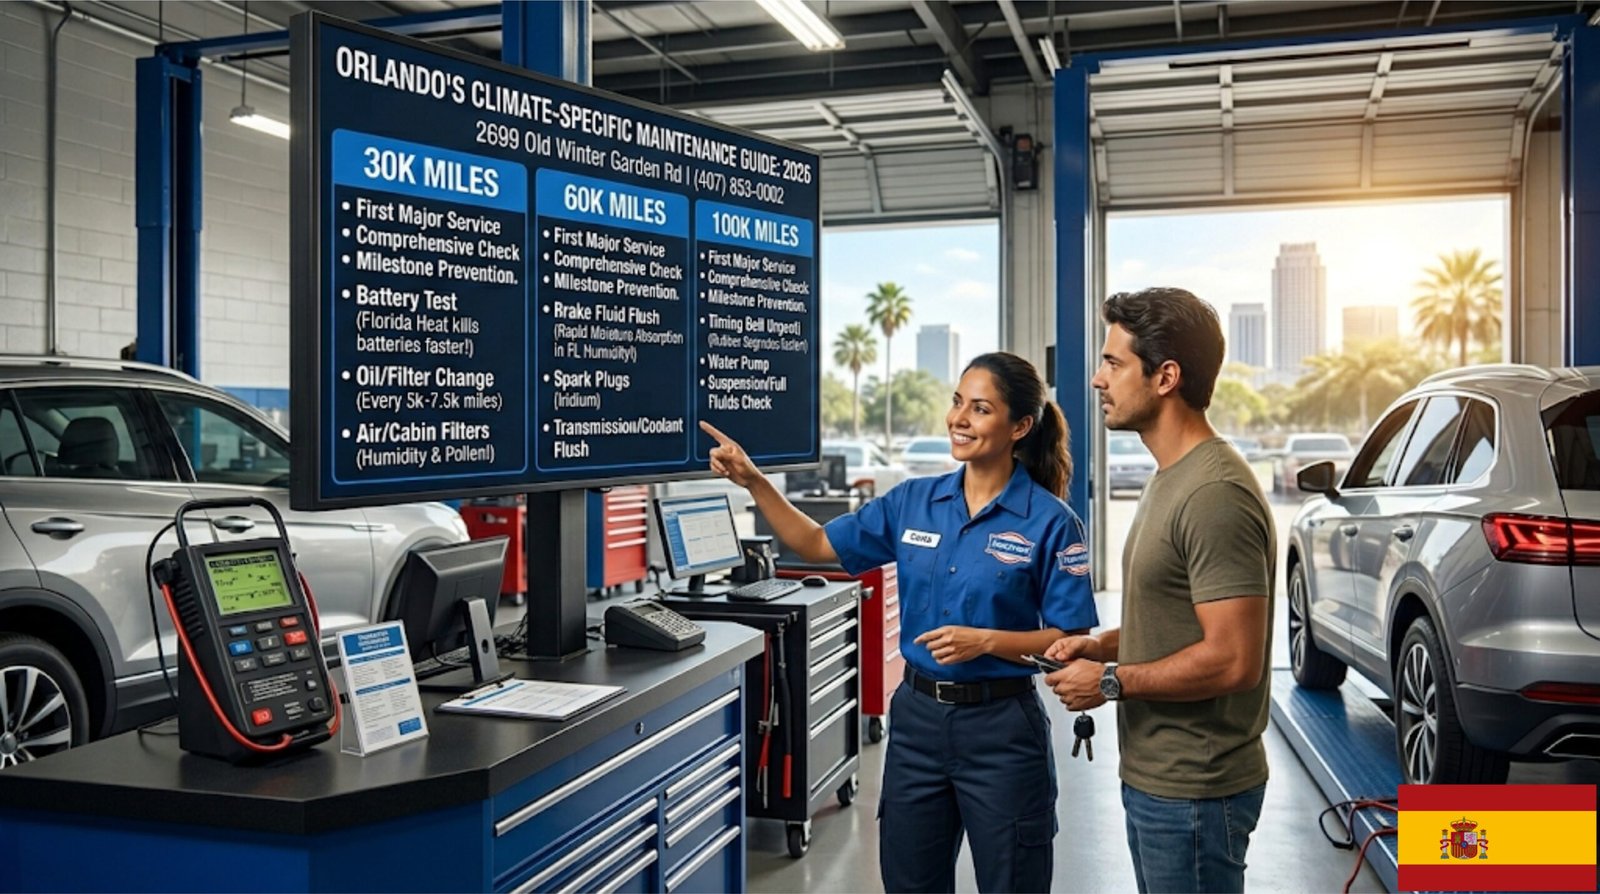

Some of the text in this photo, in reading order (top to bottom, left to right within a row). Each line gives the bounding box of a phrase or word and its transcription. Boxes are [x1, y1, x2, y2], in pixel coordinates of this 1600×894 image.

[336, 46, 812, 184] ORLANDO'S CLIMATE-SPECIFIC MAINTENANCE GUIDE: 2026
[363, 146, 499, 199] 30K MILES
[476, 120, 520, 150] 2699
[525, 130, 551, 157] Old
[555, 136, 606, 168] Winter
[611, 149, 660, 180] Garden
[664, 162, 682, 185] Rd
[694, 168, 726, 197] (407)
[729, 178, 784, 205] 853-0002
[564, 183, 666, 225] 60K MILES
[356, 198, 501, 235] First Major Service
[712, 211, 799, 247] 100K MILES
[356, 225, 520, 261] Comprehensive Check
[554, 227, 665, 258] First Major Service
[356, 251, 518, 285] Milestone Prevention.
[554, 250, 682, 280] Comprehensive Check
[708, 250, 796, 274] First Major Service
[554, 272, 680, 300] Milestone Prevention.
[708, 269, 809, 295] Comprehensive Check
[356, 284, 458, 312] Battery Test
[708, 289, 807, 313] Milestone Prevention.
[356, 311, 480, 334] (Florida Heat kills
[554, 301, 660, 325] Brake Fluid Flush
[708, 313, 743, 333] Timing
[356, 334, 474, 358] batteries faster!)
[554, 323, 588, 341] (Rapid
[635, 329, 683, 346] Absorption
[554, 343, 564, 357] in
[567, 343, 581, 358] FL
[708, 353, 769, 374] Water Pump
[356, 365, 494, 390] Oil/Filter Change
[554, 369, 630, 391] Spark Plugs
[708, 374, 787, 393] Suspension/Full
[356, 392, 502, 412] (Every 5k-7.5k miles)
[554, 392, 601, 410] (Iridium)
[709, 394, 772, 410] Fluids Check
[356, 422, 490, 443] Air/Cabin Filters
[554, 417, 683, 435] Transmission/Coolant
[356, 447, 427, 470] (Humidity
[431, 446, 441, 463] &
[554, 440, 589, 458] Flush
